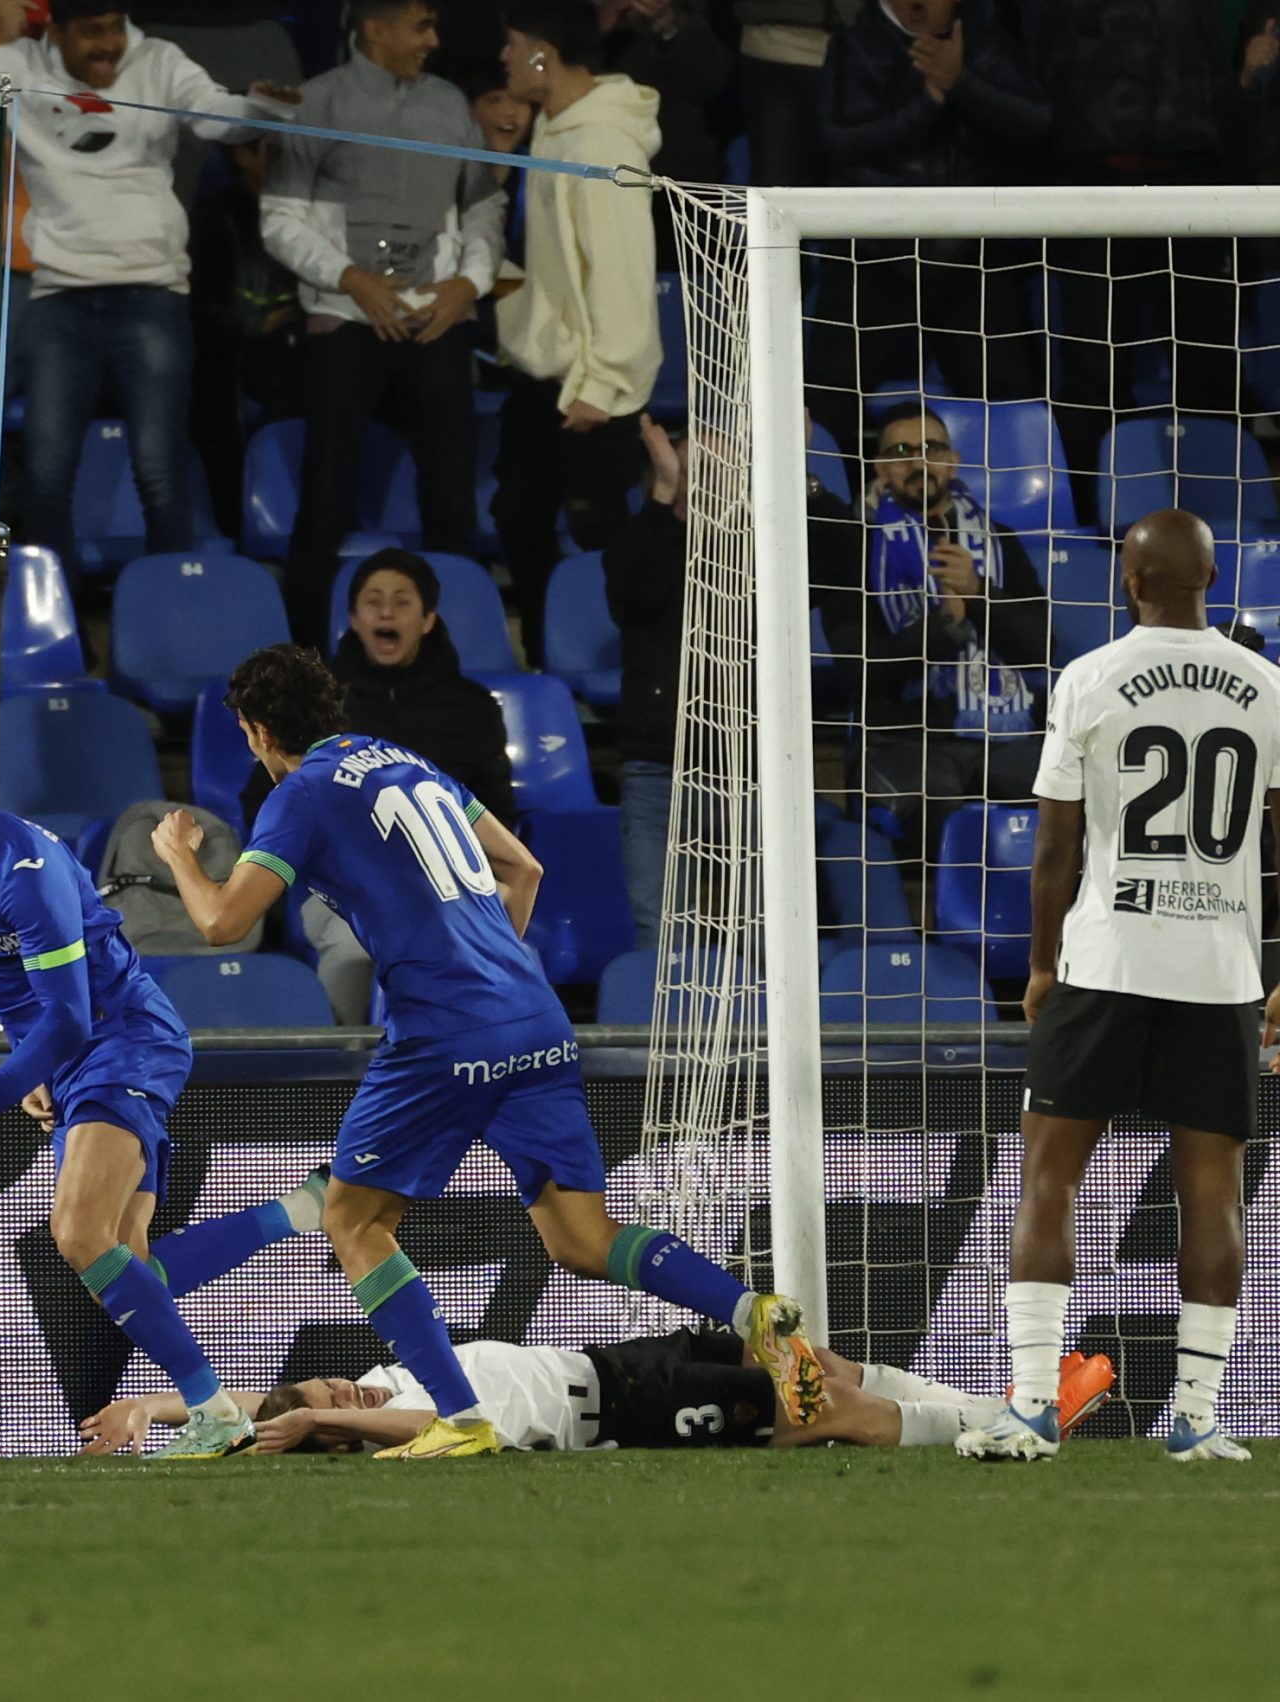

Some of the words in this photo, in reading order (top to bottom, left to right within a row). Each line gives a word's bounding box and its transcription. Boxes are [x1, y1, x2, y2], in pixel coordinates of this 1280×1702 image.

[1118, 663, 1260, 712] FOULQUIER
[1118, 725, 1259, 866] 20
[370, 780, 497, 902] 10
[1157, 894, 1247, 914] BRIGANTINA
[1158, 880, 1222, 898] HERRERO
[674, 1403, 725, 1438] 3
